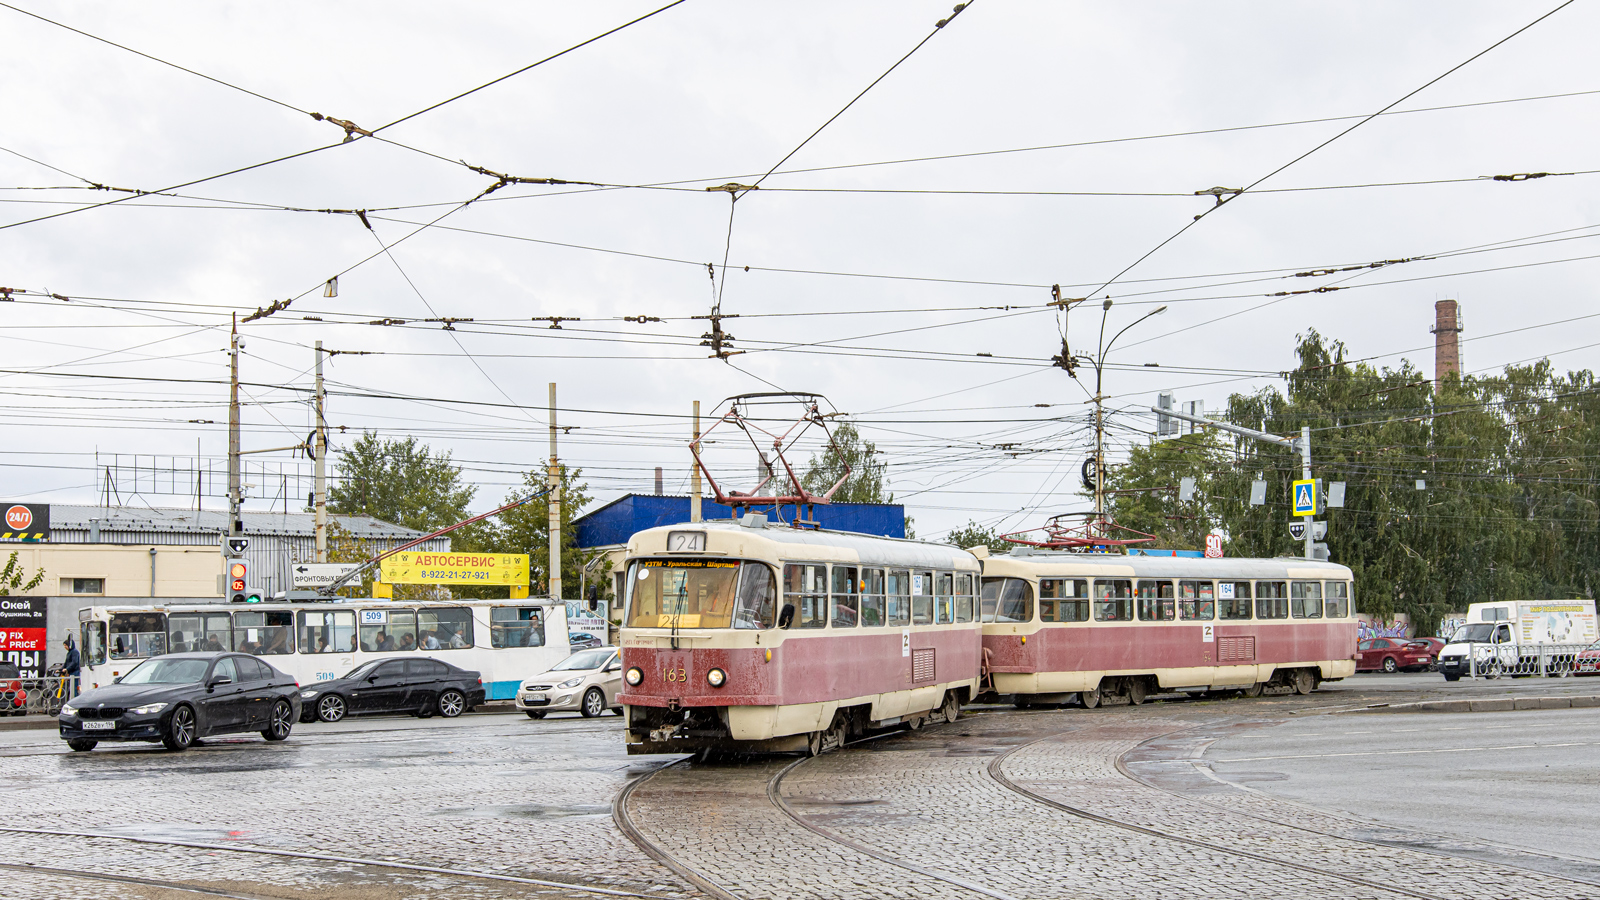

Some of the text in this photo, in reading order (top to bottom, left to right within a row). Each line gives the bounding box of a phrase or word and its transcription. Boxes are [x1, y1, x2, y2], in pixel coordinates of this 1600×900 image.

[9, 512, 30, 522] 24/7
[676, 535, 698, 551] 24
[415, 555, 495, 567] АВТОСЕРВИС
[421, 570, 490, 579] 8-922-21-27-921
[1221, 584, 1232, 594] 164
[1, 600, 31, 610] Окей
[366, 611, 382, 620] 509
[9, 632, 24, 640] FIX
[315, 672, 335, 681] 509
[663, 668, 688, 682] 163
